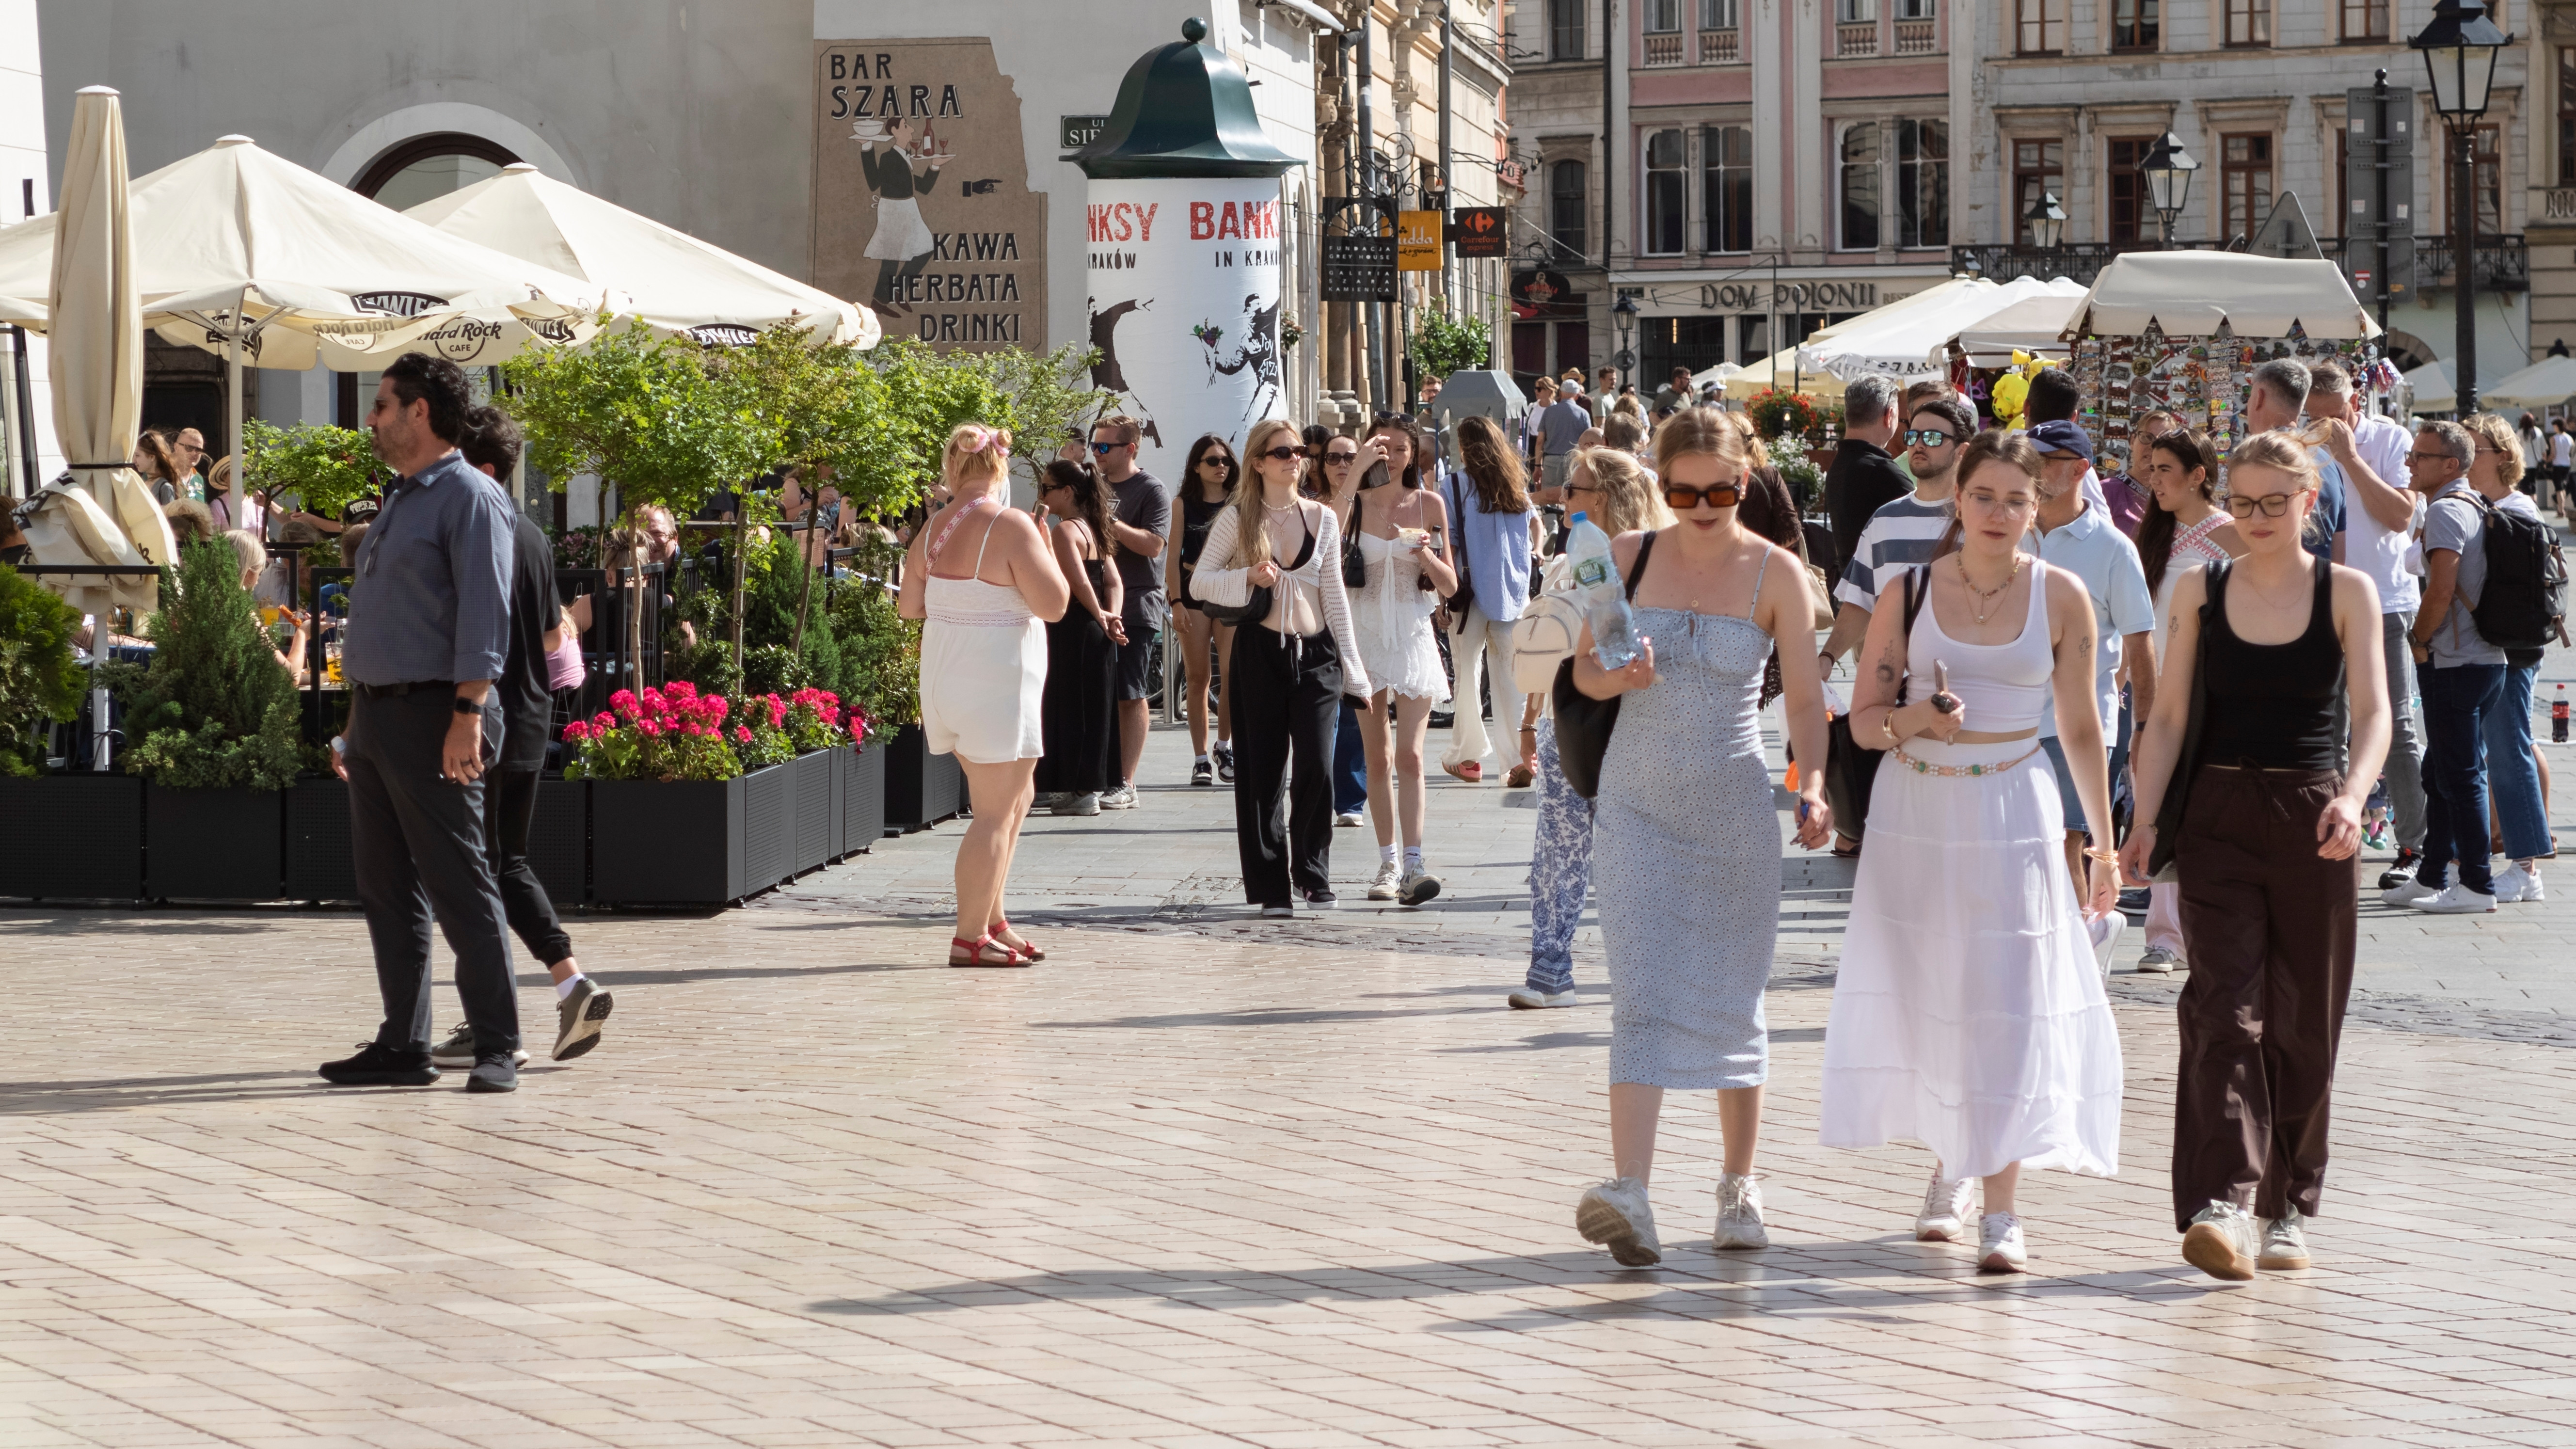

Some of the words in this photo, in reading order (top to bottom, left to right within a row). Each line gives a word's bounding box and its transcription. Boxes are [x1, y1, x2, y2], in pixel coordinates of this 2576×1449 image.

[830, 54, 892, 80] BAR
[831, 84, 963, 120] SZARA
[1087, 203, 1159, 242] NKSY
[933, 233, 1020, 262] KAWA
[1215, 251, 1232, 267] IN
[888, 274, 1021, 303] HERBATA
[1700, 283, 1757, 310] DOM
[1775, 281, 1876, 310] POLONII
[461, 321, 502, 341] Rock
[920, 314, 1021, 343] DRINKI
[1579, 566, 1587, 580] 8
[1584, 562, 1599, 574] MLN
